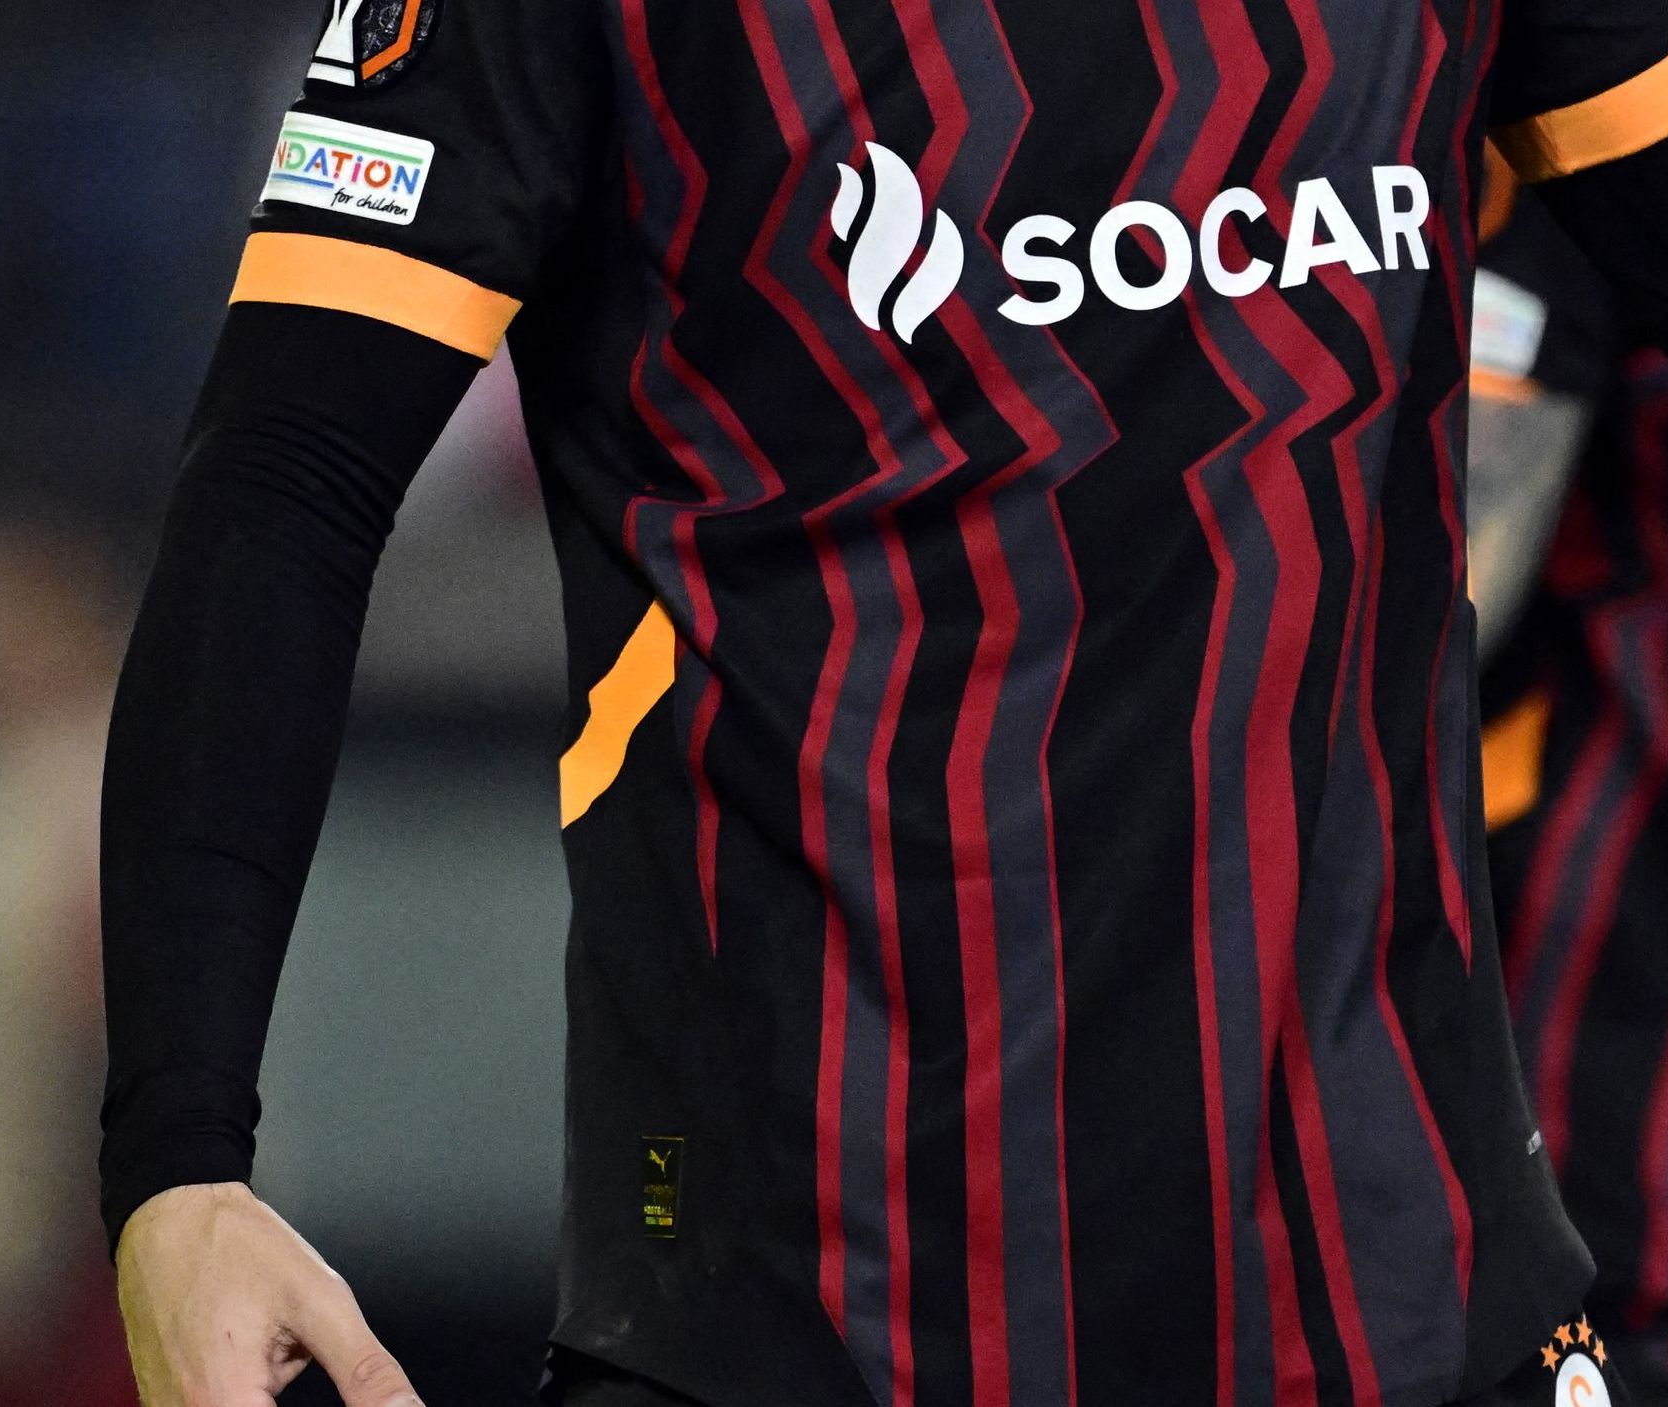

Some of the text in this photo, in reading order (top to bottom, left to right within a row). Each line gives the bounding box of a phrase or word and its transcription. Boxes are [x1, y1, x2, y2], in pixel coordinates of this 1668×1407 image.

[331, 187, 409, 216] for children
[997, 165, 1430, 327] SOCAR
